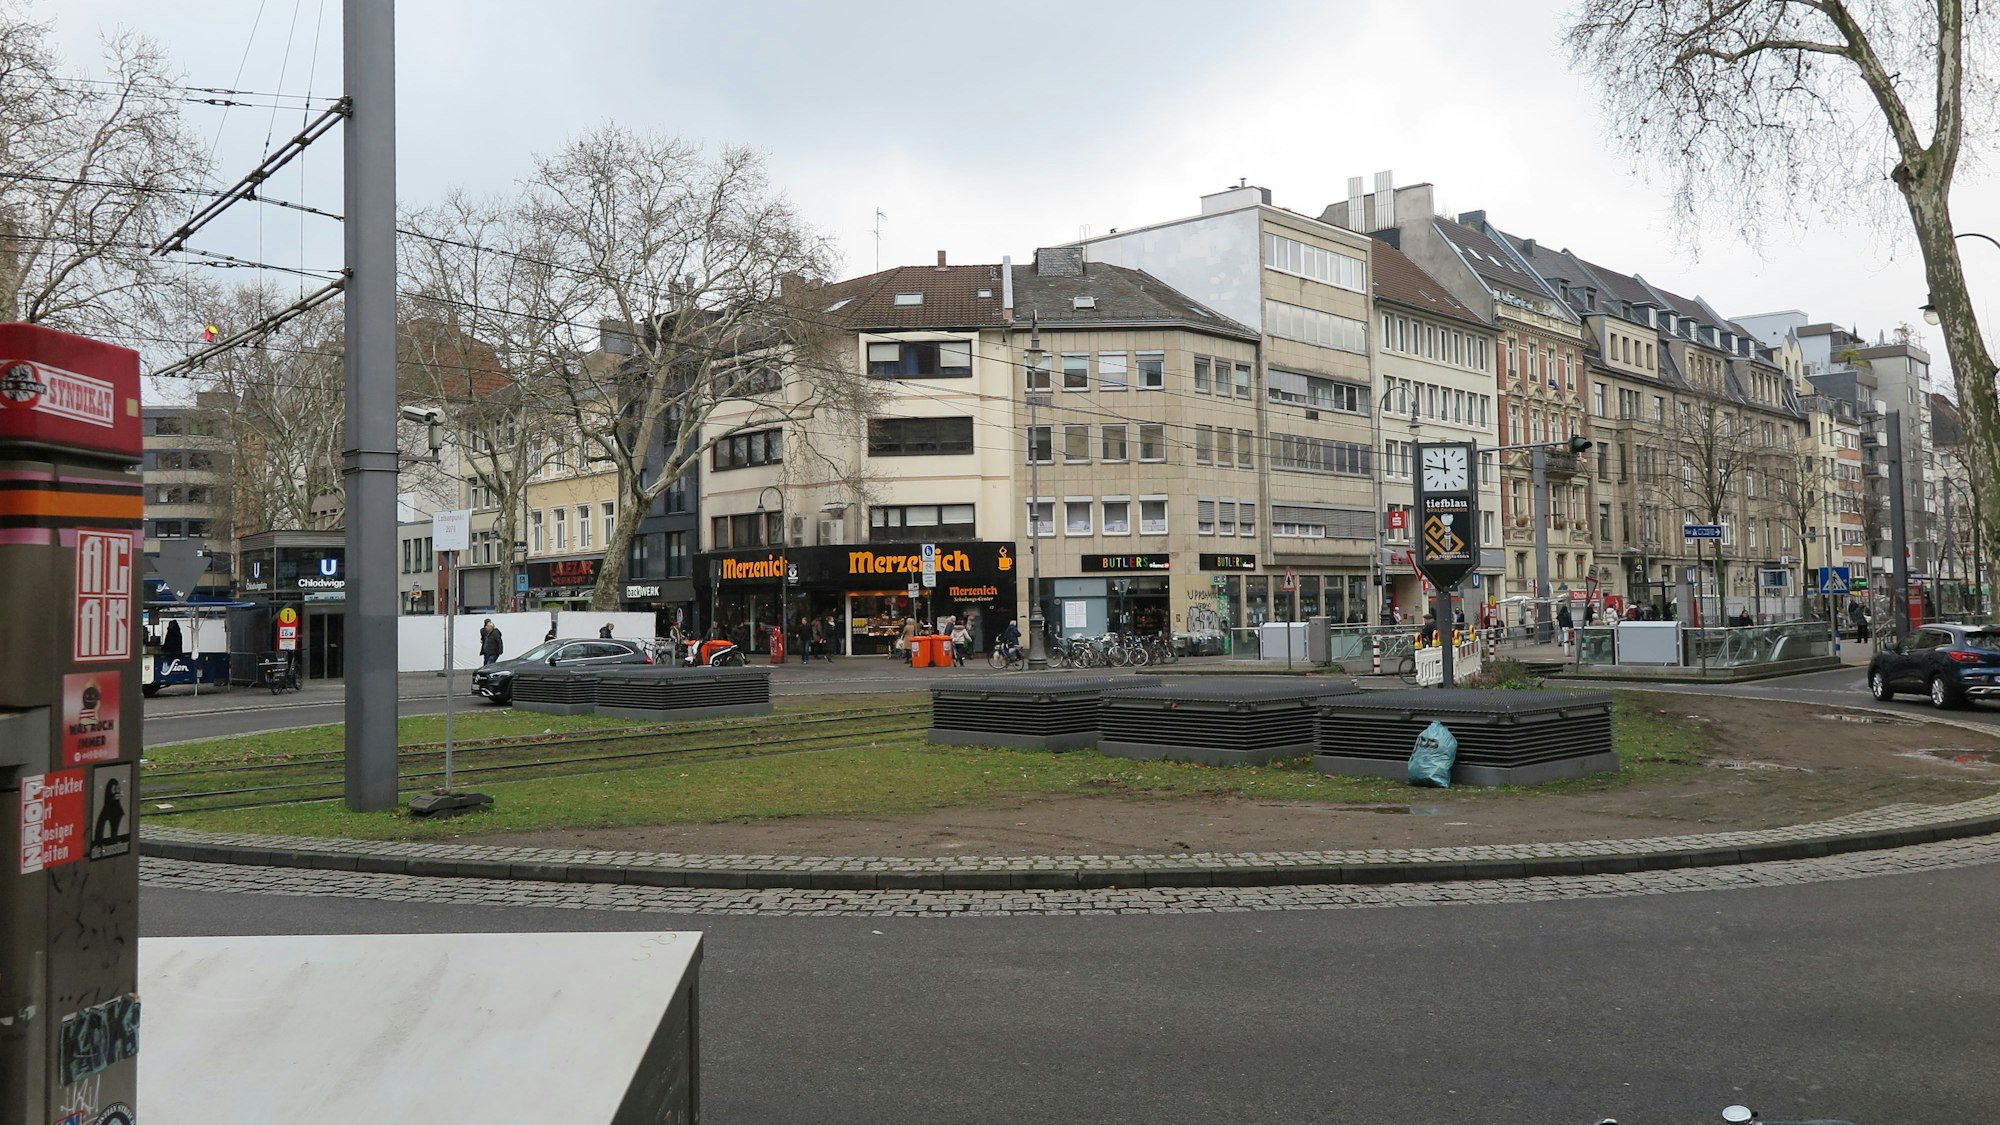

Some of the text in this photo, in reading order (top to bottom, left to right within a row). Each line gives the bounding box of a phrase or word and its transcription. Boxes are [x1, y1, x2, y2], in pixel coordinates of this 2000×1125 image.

[49, 377, 112, 419] SYNDIKAT
[1426, 499, 1468, 508] tiefblau
[849, 548, 970, 574] Merzeich
[1102, 557, 1148, 569] BUTLERS
[1217, 556, 1243, 568] BUTLERS
[321, 560, 337, 575] U
[1473, 575, 1479, 586] U
[950, 585, 998, 596] Merzenich
[160, 658, 189, 676] Sion
